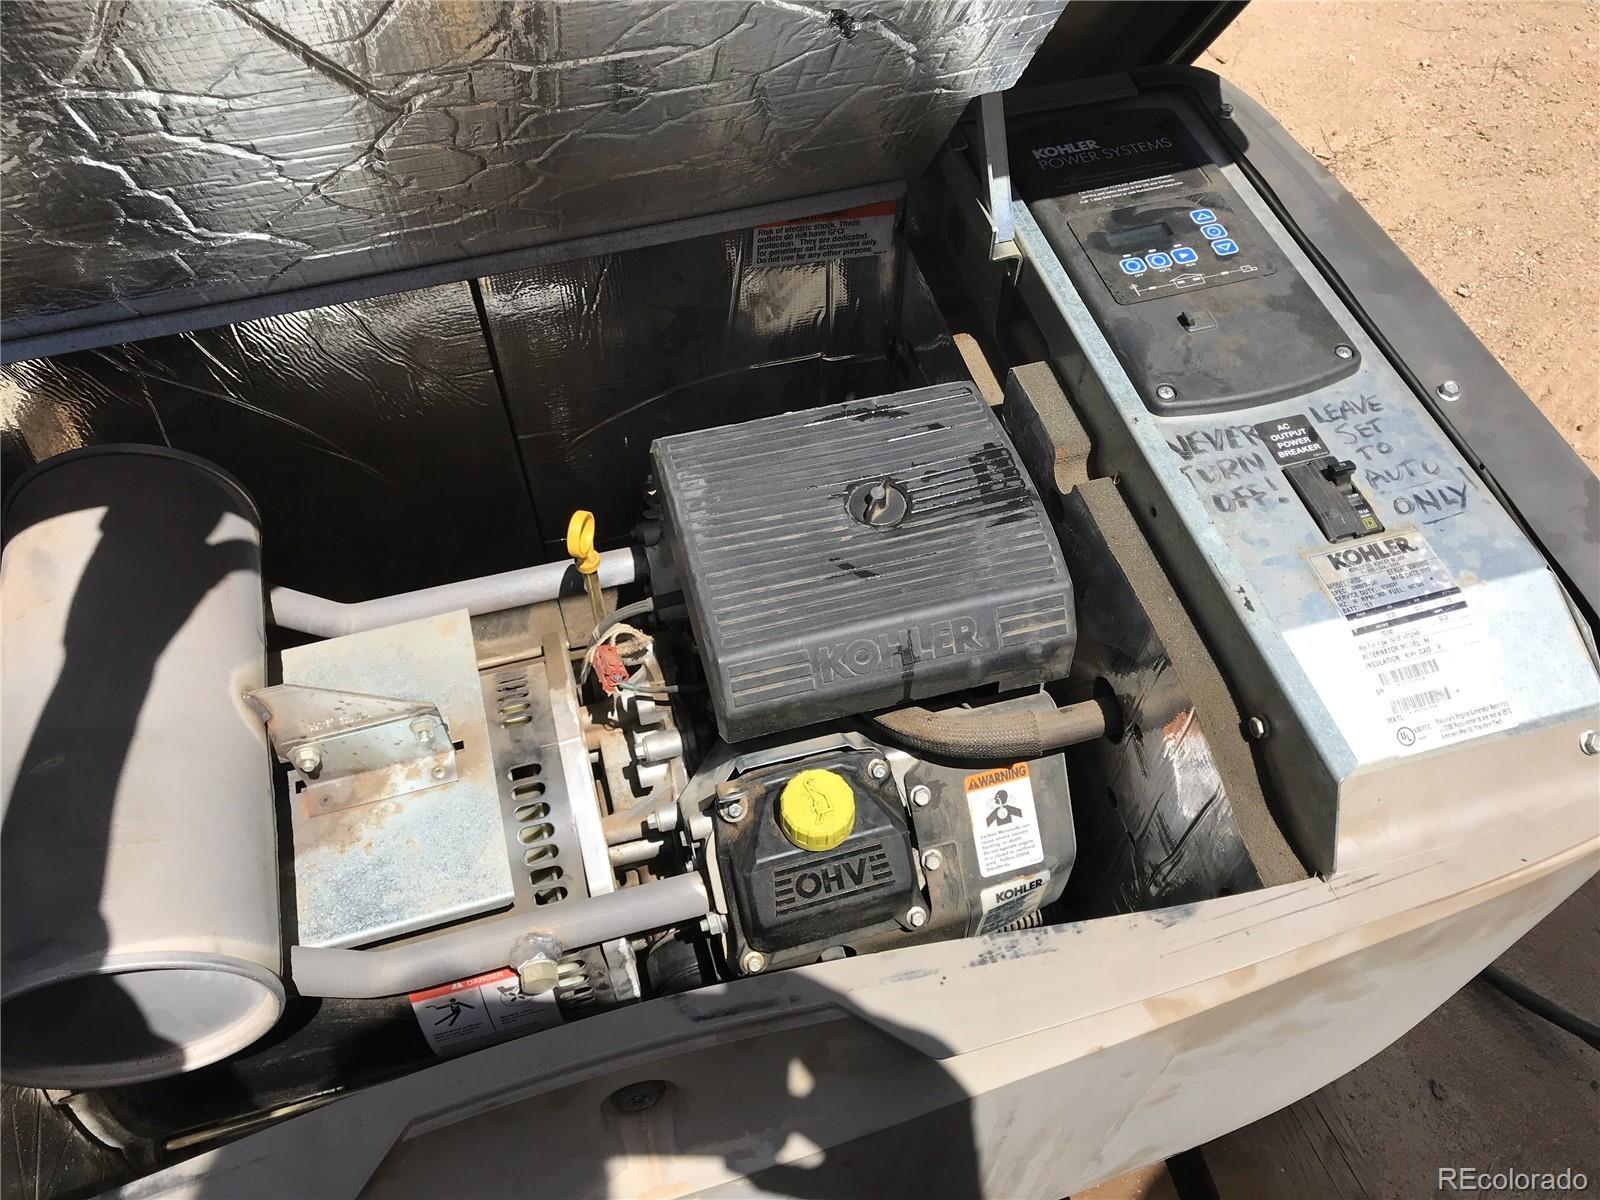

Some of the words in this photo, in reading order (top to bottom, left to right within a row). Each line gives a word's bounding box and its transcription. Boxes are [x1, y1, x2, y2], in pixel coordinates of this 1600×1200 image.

[1032, 139, 1100, 160] KOHLER
[1039, 151, 1100, 171] POWER
[1102, 137, 1172, 159] SYSTEMS
[758, 228, 773, 236] Risk
[785, 224, 812, 233] electric
[758, 235, 782, 243] outlets
[795, 231, 807, 239] not
[809, 229, 826, 238] have
[800, 238, 817, 246] They
[832, 232, 868, 242] dedicated
[757, 249, 767, 257] for
[769, 246, 804, 257] generator
[805, 244, 816, 252] set
[818, 240, 860, 250] accessories
[808, 251, 820, 259] any
[823, 249, 841, 257] other
[1308, 394, 1384, 424] LEAVE
[1270, 428, 1307, 441] OUTPUT
[1277, 423, 1290, 431] AC
[1334, 417, 1382, 444] SET
[1165, 424, 1261, 461] NEVER
[1277, 436, 1312, 449] POWER
[1277, 443, 1322, 458] BREAKER
[1355, 441, 1394, 460] TO
[1179, 452, 1267, 489] TURN
[1364, 459, 1440, 490] AUTO
[818, 615, 984, 684] KOHLER
[978, 765, 1027, 788] WARNING
[795, 857, 867, 899] OHV
[995, 878, 1044, 903] KOHLER
[466, 972, 504, 986] DANGER
